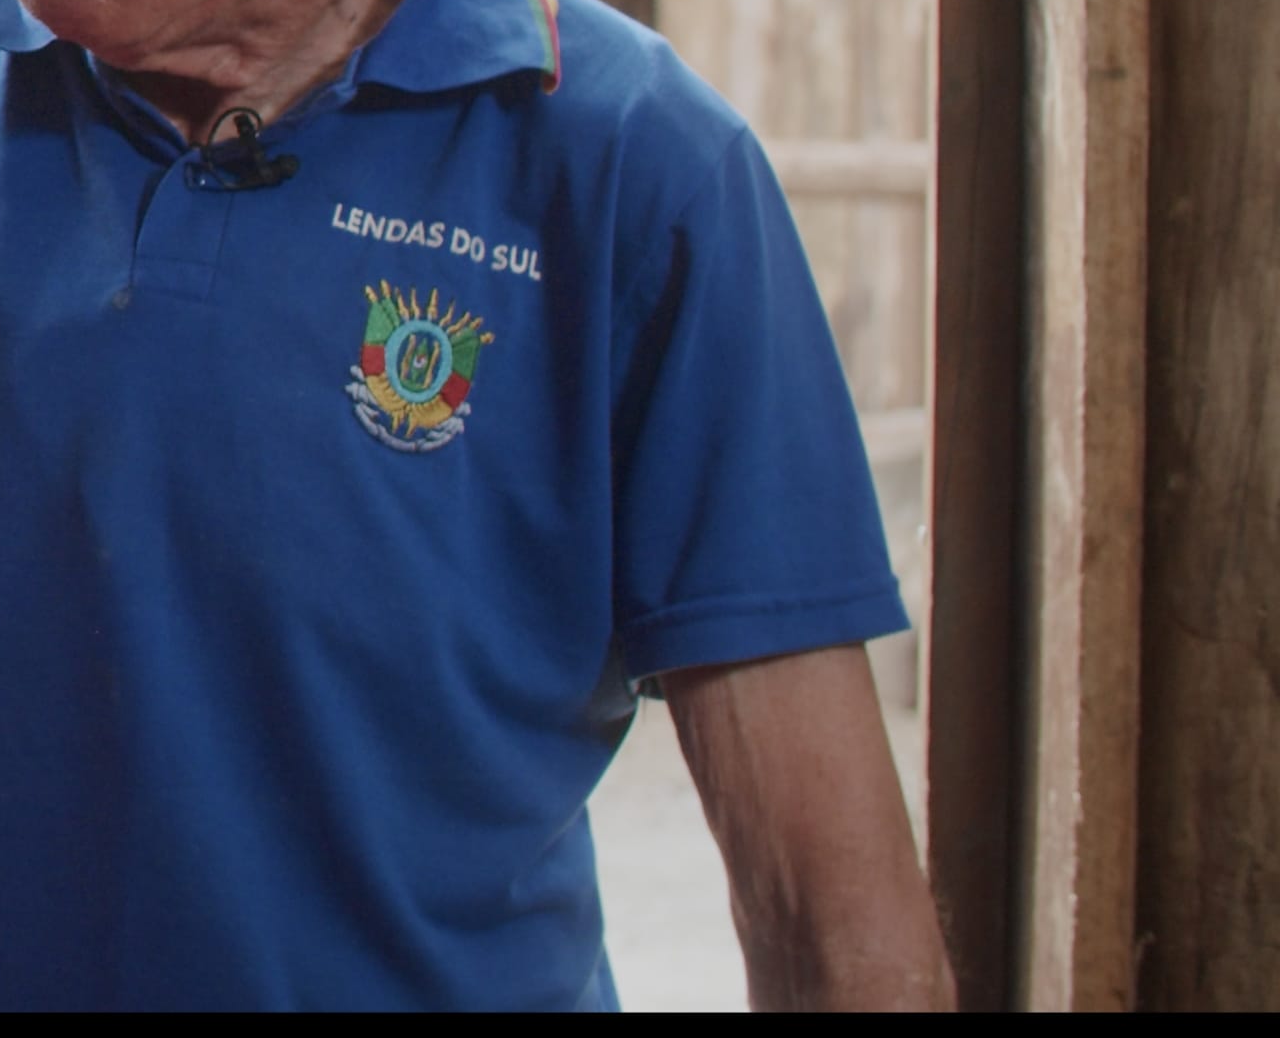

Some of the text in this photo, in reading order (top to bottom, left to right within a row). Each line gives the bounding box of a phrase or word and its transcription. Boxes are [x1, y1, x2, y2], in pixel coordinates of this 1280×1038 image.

[331, 203, 542, 281] LENDAS DO SUL
